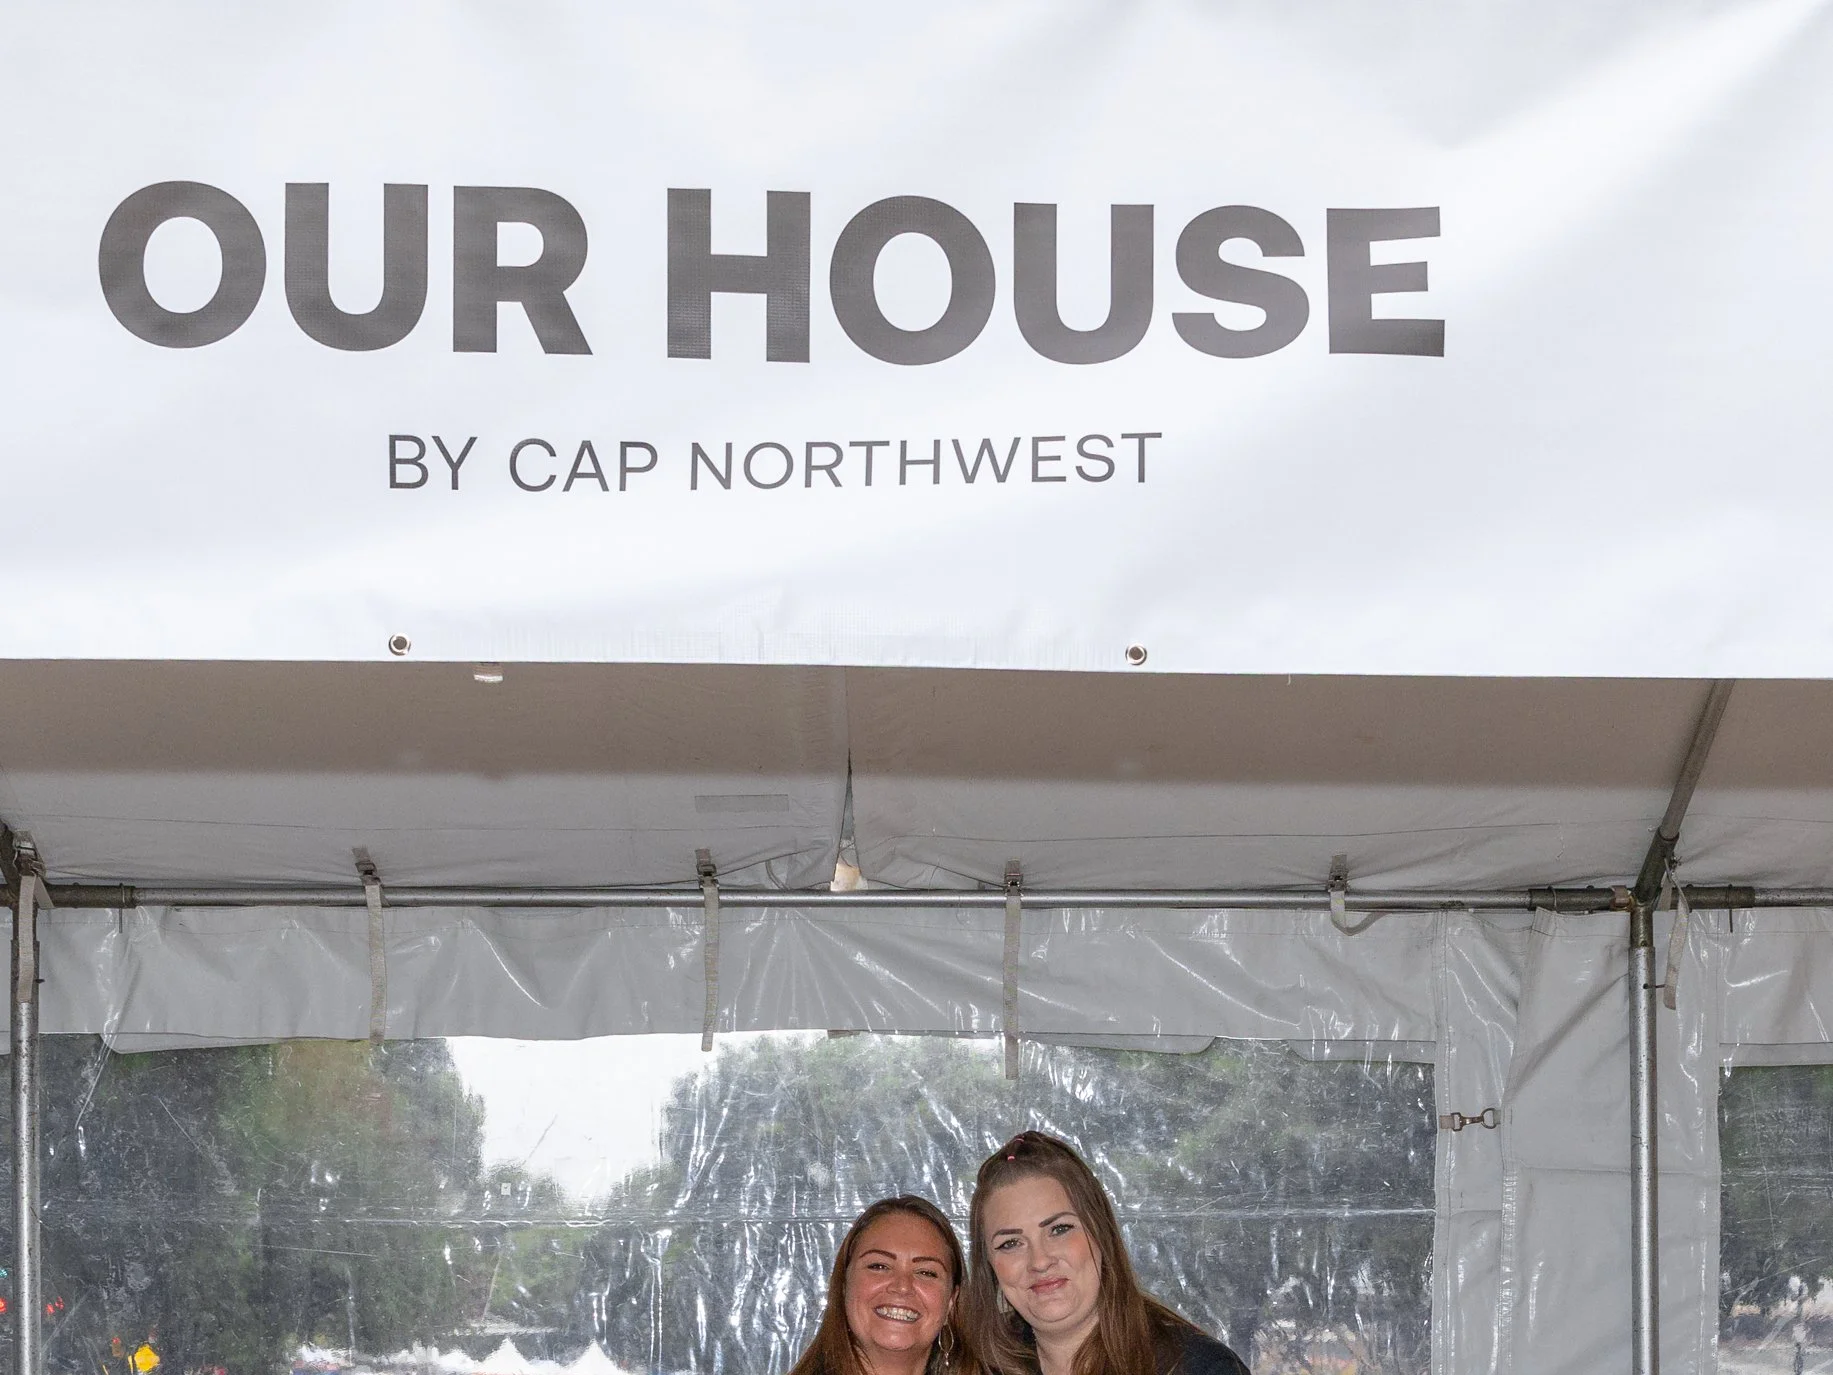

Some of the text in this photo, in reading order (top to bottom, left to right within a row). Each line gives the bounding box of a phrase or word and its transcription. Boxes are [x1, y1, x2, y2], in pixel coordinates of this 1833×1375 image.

[98, 180, 1446, 366] OUR HOUSE
[388, 432, 1163, 493] BY CAP NORTHWEST
